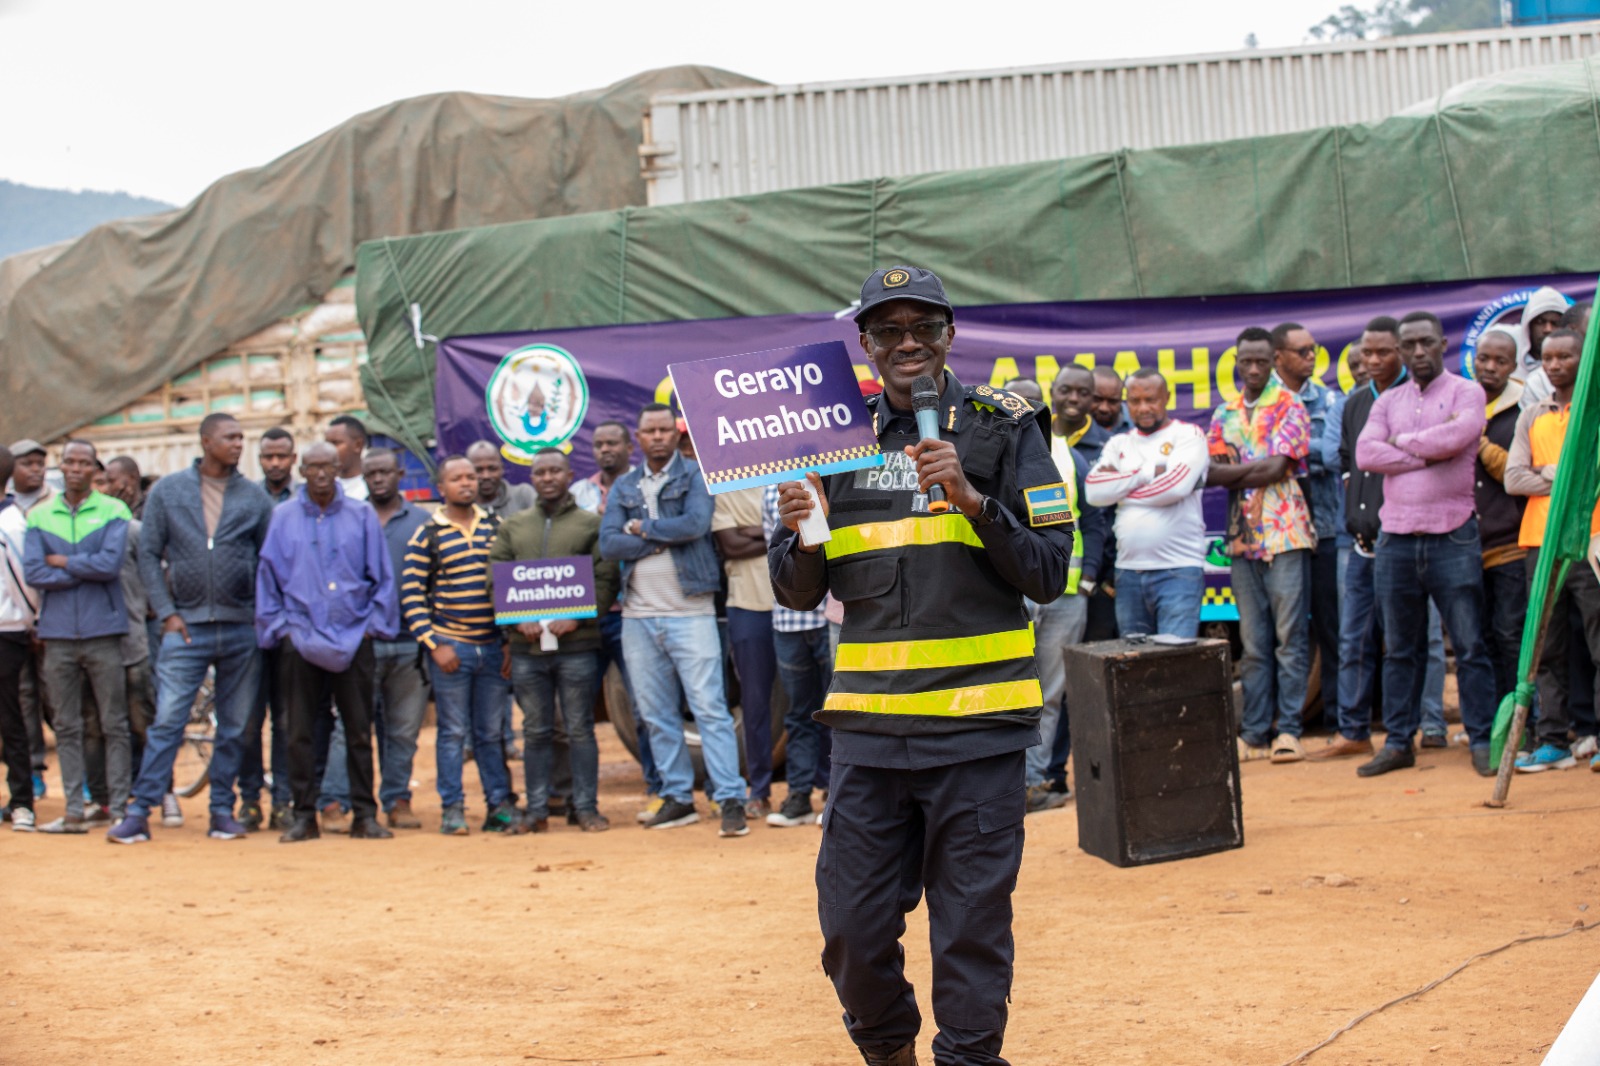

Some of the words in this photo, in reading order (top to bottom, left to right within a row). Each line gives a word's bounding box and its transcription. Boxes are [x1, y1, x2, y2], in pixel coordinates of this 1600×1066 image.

[1465, 301, 1502, 347] RWANDA
[714, 362, 823, 399] Gerayo
[1013, 406, 1030, 420] POLIC
[718, 402, 852, 446] Amahoro
[867, 470, 921, 490] POLIC
[1034, 512, 1071, 523] RWANDA
[512, 564, 576, 582] Gerayo
[506, 584, 585, 603] Amahoro
